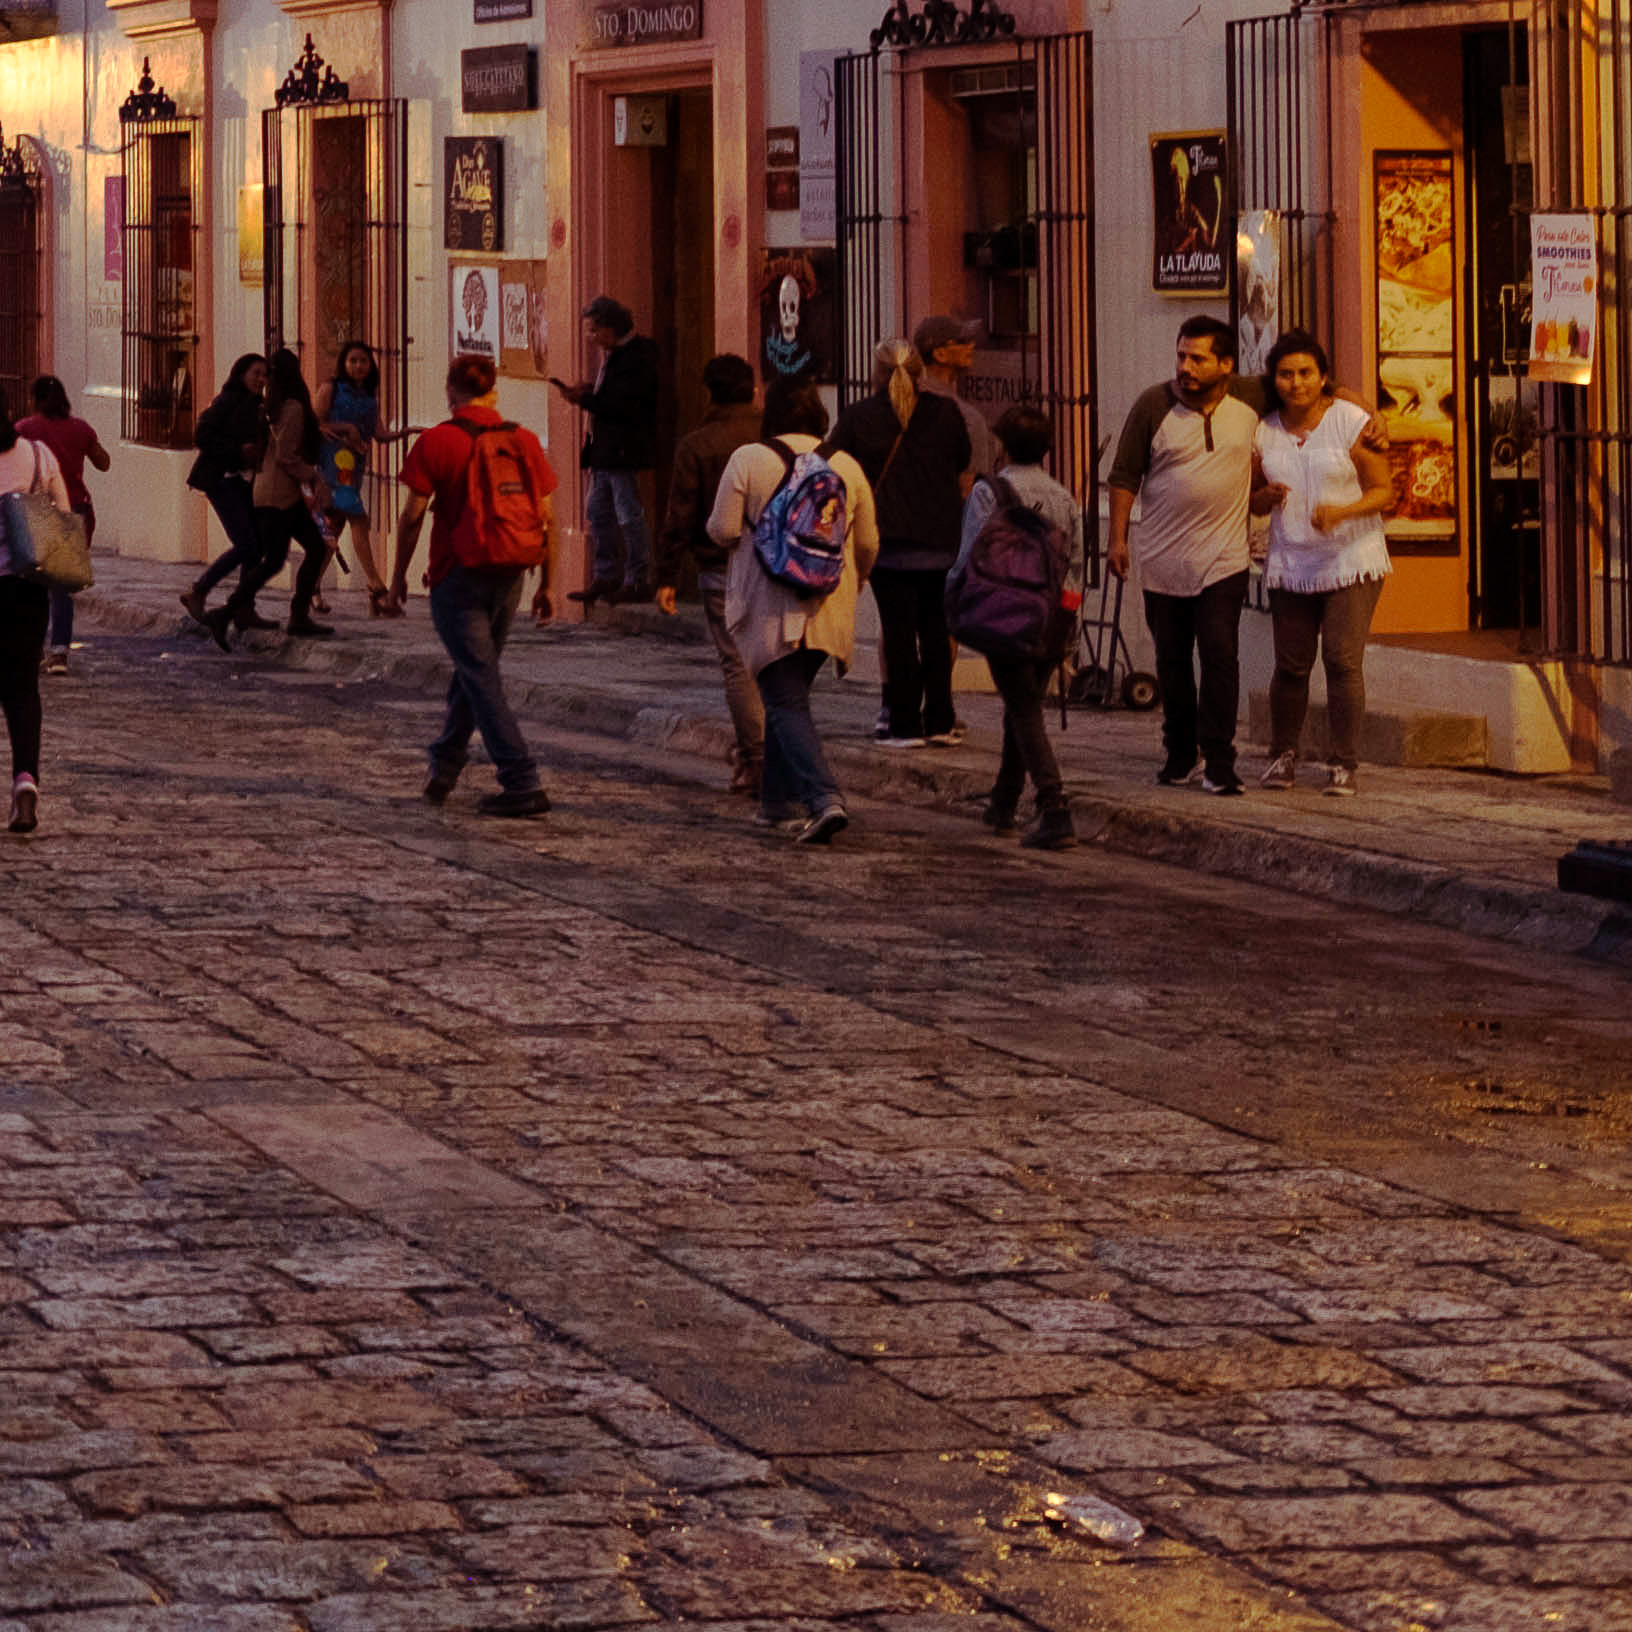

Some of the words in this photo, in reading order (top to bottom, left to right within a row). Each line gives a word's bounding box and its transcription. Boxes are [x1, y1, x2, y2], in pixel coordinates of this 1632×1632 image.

[627, 5, 695, 35] DOMINGO
[1159, 252, 1174, 273] LA
[1175, 250, 1221, 272] TLAYUDA
[1537, 246, 1592, 260] SMOOTHIES
